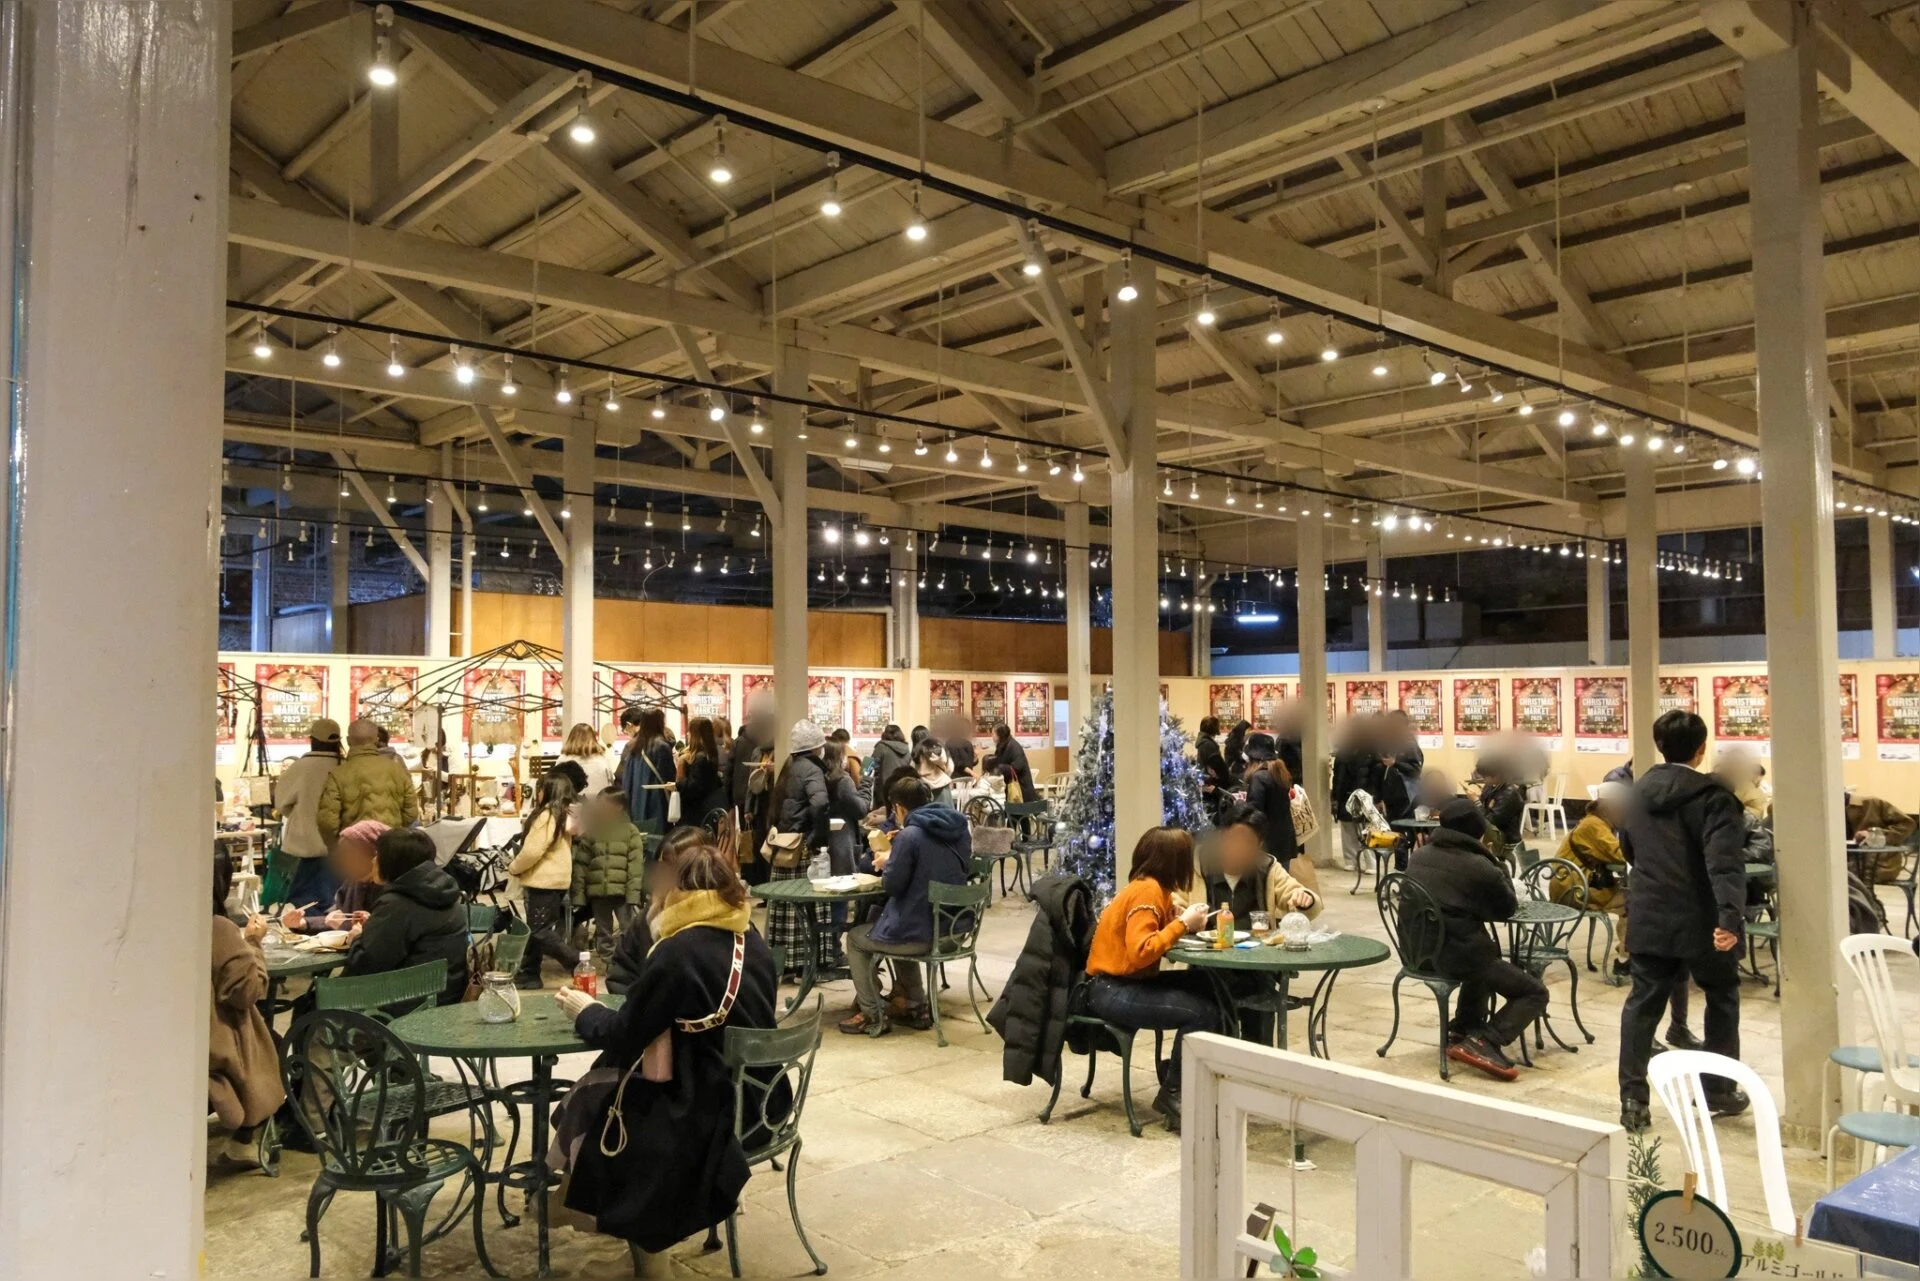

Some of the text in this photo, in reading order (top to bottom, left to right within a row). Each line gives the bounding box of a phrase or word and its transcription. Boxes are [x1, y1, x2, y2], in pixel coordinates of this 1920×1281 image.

[1405, 698, 1434, 706] CHRISTMAS
[1460, 698, 1492, 706] CHRISTMAS
[1519, 698, 1554, 706] CHRISTMAS
[1583, 698, 1619, 706] CHRISTMAS
[1659, 698, 1690, 706] RISTMAS
[1722, 698, 1766, 707] CHRISTMAS
[1887, 697, 1919, 707] CHRIST
[272, 704, 311, 715] MARKET
[1409, 707, 1433, 715] MARKET
[1464, 706, 1489, 715] MARKET
[1523, 706, 1549, 715] MARKET
[1587, 707, 1615, 716] MARKET
[1728, 707, 1760, 717] MARKET
[1893, 709, 1919, 718] MARK
